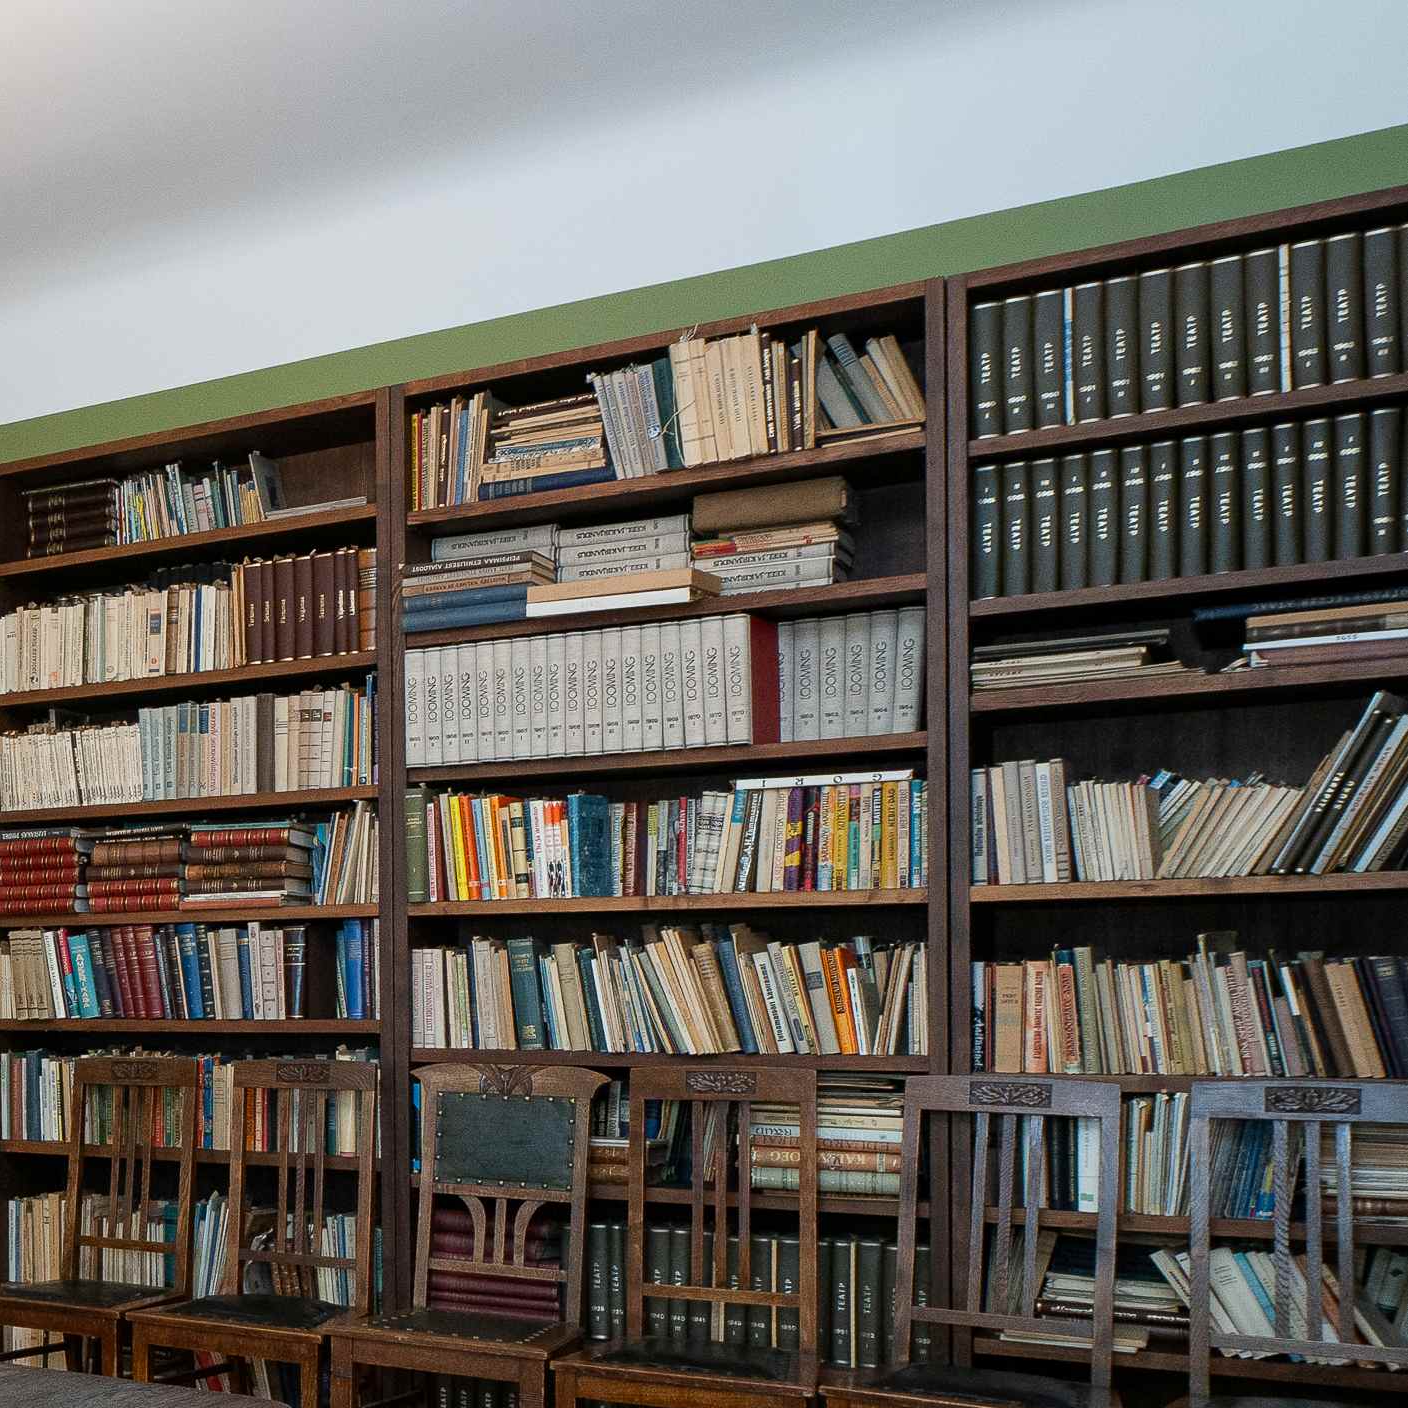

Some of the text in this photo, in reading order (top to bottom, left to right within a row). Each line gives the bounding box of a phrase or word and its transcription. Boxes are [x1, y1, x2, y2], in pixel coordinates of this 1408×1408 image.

[550, 664, 559, 712] LOOMING
[568, 663, 577, 712] LOOMING
[587, 661, 597, 710] LOOMING
[606, 659, 616, 708] LOOMING
[625, 656, 636, 705] LOOMING
[645, 654, 656, 704] LOOMING
[664, 652, 676, 702] LOOMING
[685, 650, 696, 701] LOOMING
[707, 648, 718, 698] LOOMING
[730, 646, 742, 697] LOOMING
[800, 649, 811, 700] LOOMING
[825, 648, 837, 698] LOOMING
[851, 644, 862, 696] LOOMING
[875, 641, 887, 693] LOOMING
[902, 638, 915, 690] LOOMING
[408, 676, 417, 724] LOOMING
[428, 676, 438, 723] LOOMING
[444, 674, 454, 721] LOOMING
[461, 672, 471, 720] LOOMING
[479, 671, 488, 718] LOOMING
[496, 668, 506, 716] LOOMING
[515, 667, 526, 715] LOOMING
[534, 665, 543, 713] LOOMING
